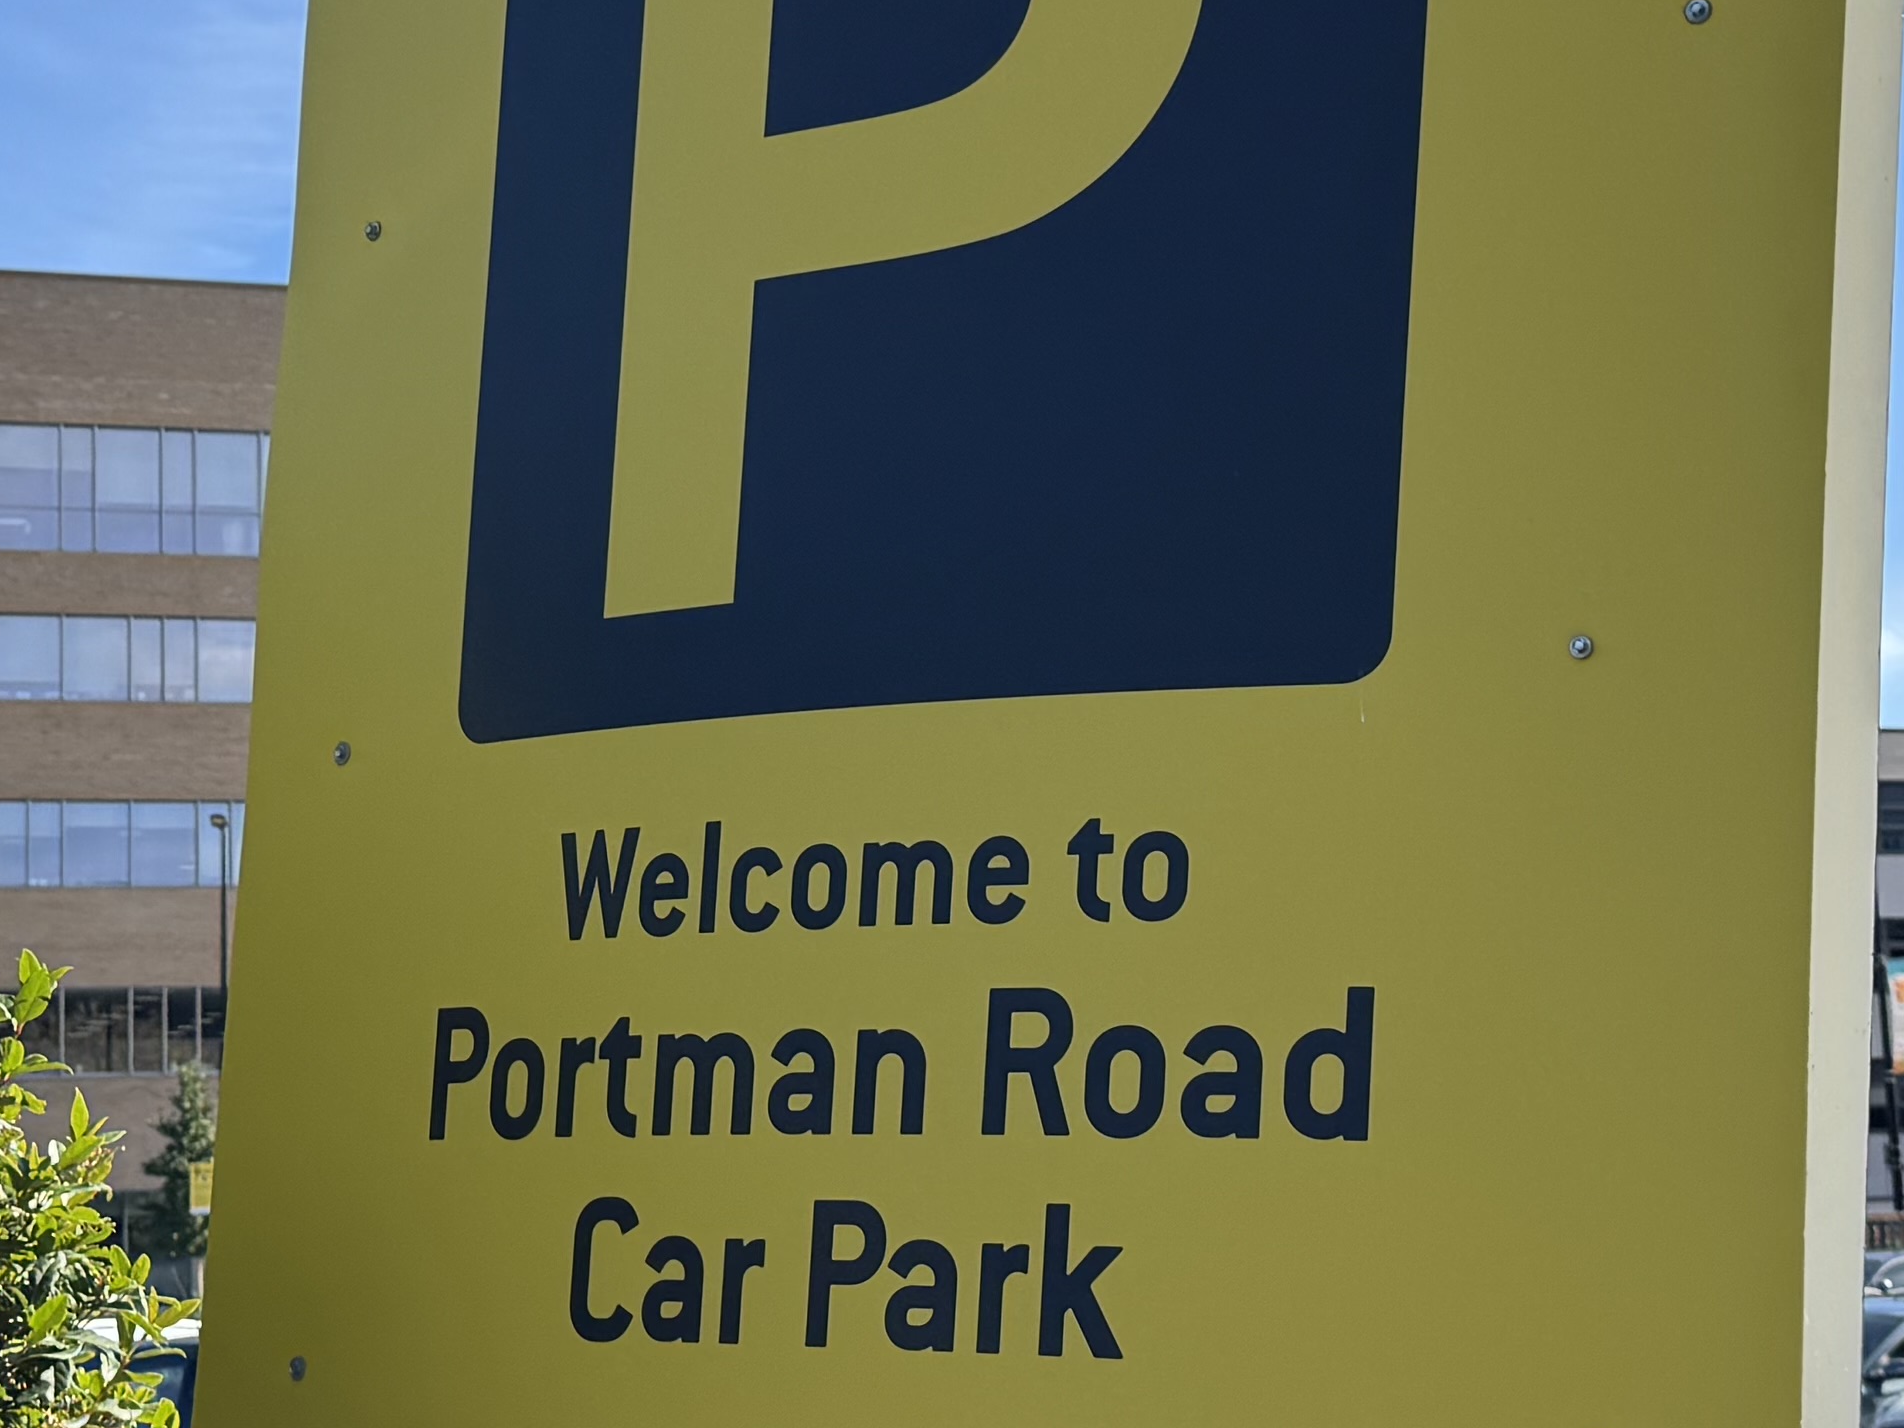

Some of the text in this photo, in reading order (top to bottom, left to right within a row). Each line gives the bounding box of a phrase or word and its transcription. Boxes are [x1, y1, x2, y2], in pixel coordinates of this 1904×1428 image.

[560, 817, 1189, 941] Welcome to
[429, 986, 1375, 1142] Portman Road
[569, 1195, 1124, 1360] Car Park
